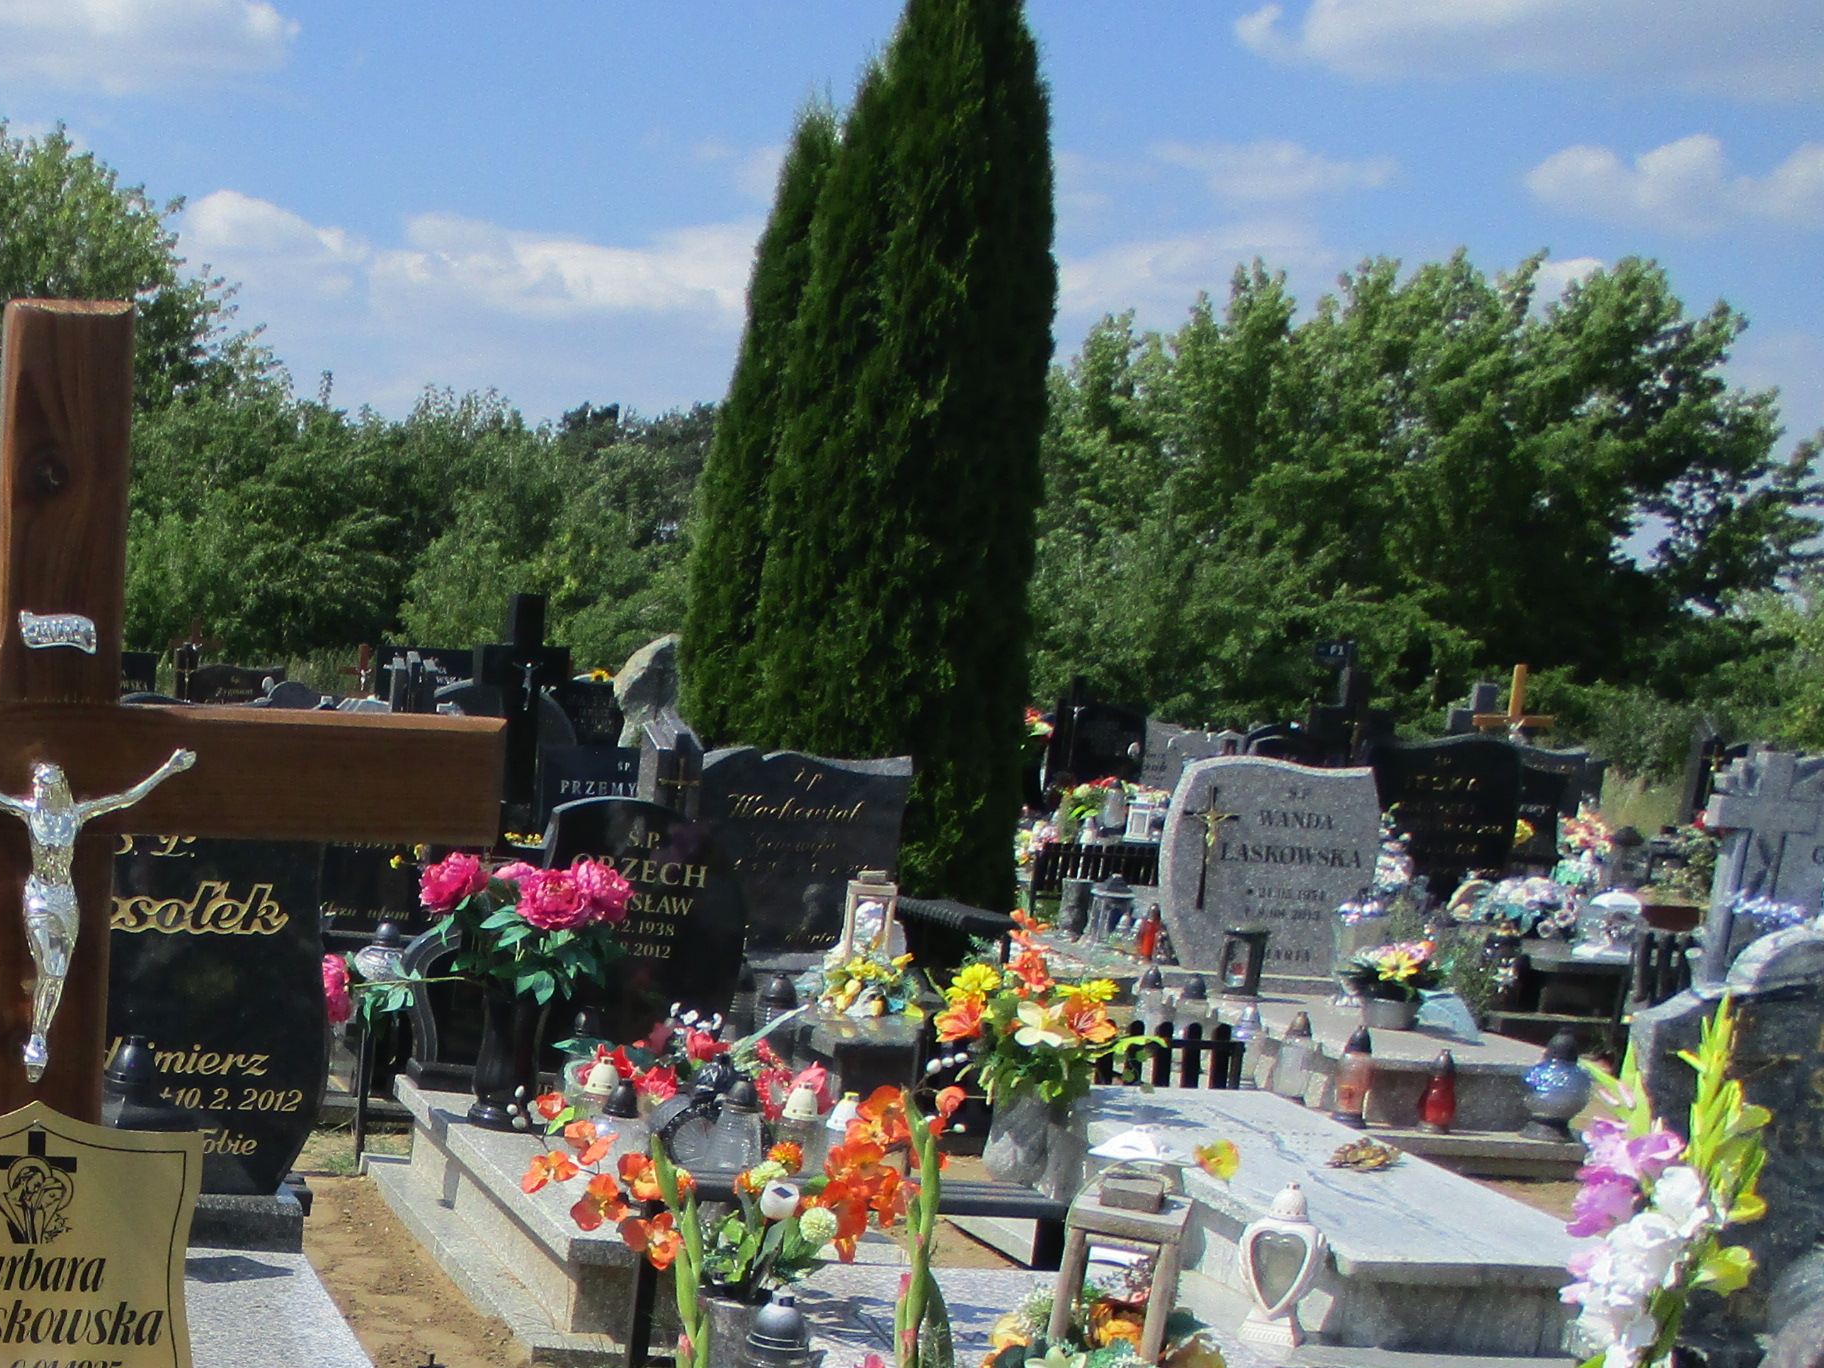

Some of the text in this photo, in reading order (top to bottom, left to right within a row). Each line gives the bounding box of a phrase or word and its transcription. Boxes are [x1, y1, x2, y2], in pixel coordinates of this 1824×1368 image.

[560, 779, 639, 798] PRZEMY
[1259, 808, 1335, 831] WANDA
[110, 880, 291, 935] sołek
[623, 891, 694, 916] ISŁAW
